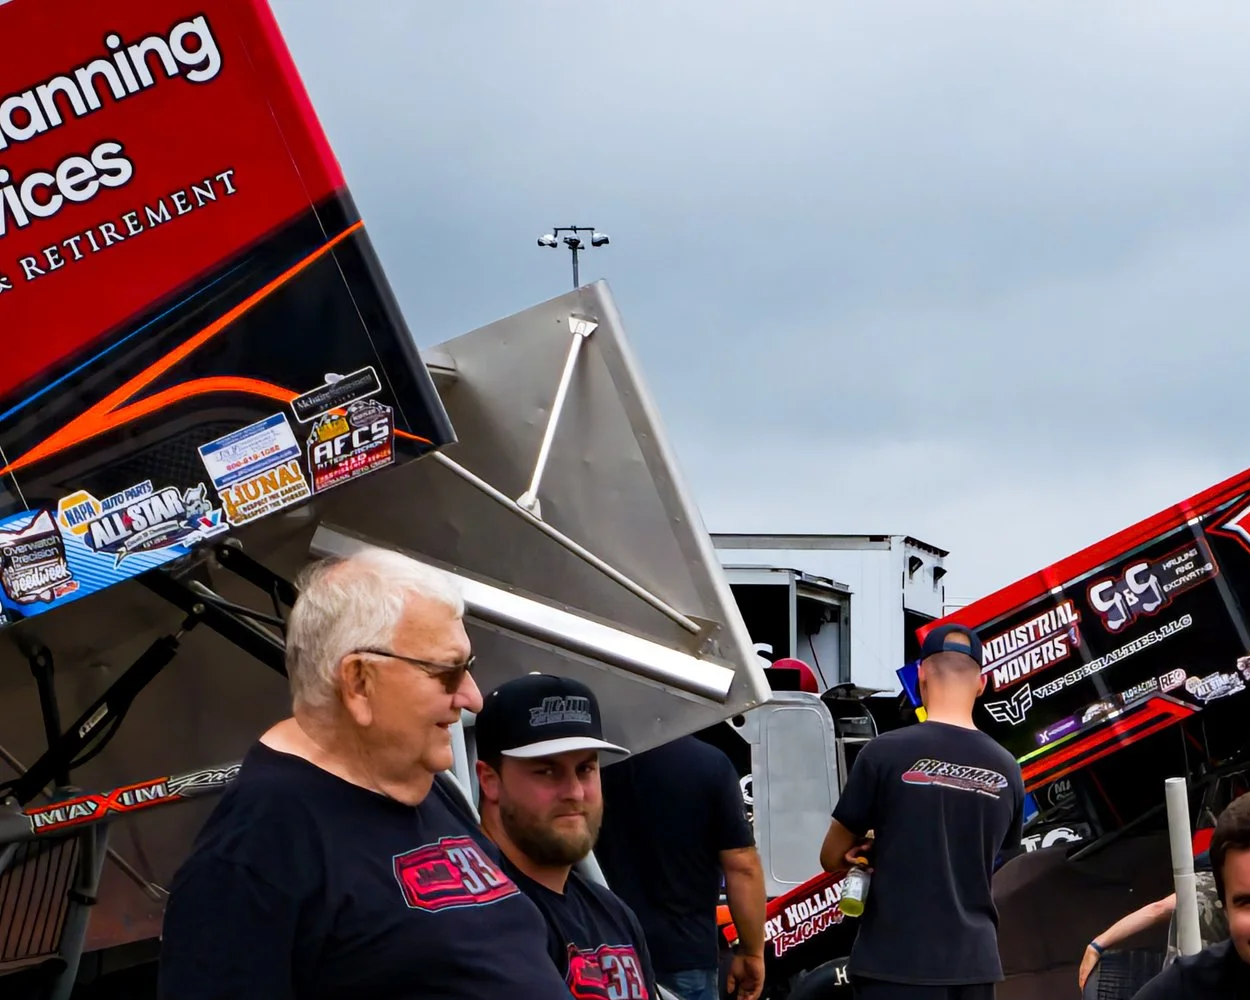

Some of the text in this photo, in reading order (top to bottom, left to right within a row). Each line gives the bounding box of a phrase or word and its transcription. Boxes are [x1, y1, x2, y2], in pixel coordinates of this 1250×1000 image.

[0, 15, 221, 149] anning
[20, 170, 236, 280] RETIREMENT
[314, 418, 389, 464] AFCS
[64, 481, 152, 527] NAPA AUTO PARTS
[90, 511, 132, 549] ALL
[127, 490, 185, 531] STAR
[3, 535, 60, 556] Overwatch
[11, 547, 59, 565] Precision
[1175, 561, 1194, 575] AND
[982, 602, 1078, 666] NDUSTRIAL
[993, 633, 1069, 688] MOVERS
[33, 782, 169, 828] MAXIM
[447, 847, 502, 894] 33
[602, 955, 643, 1000] 33
